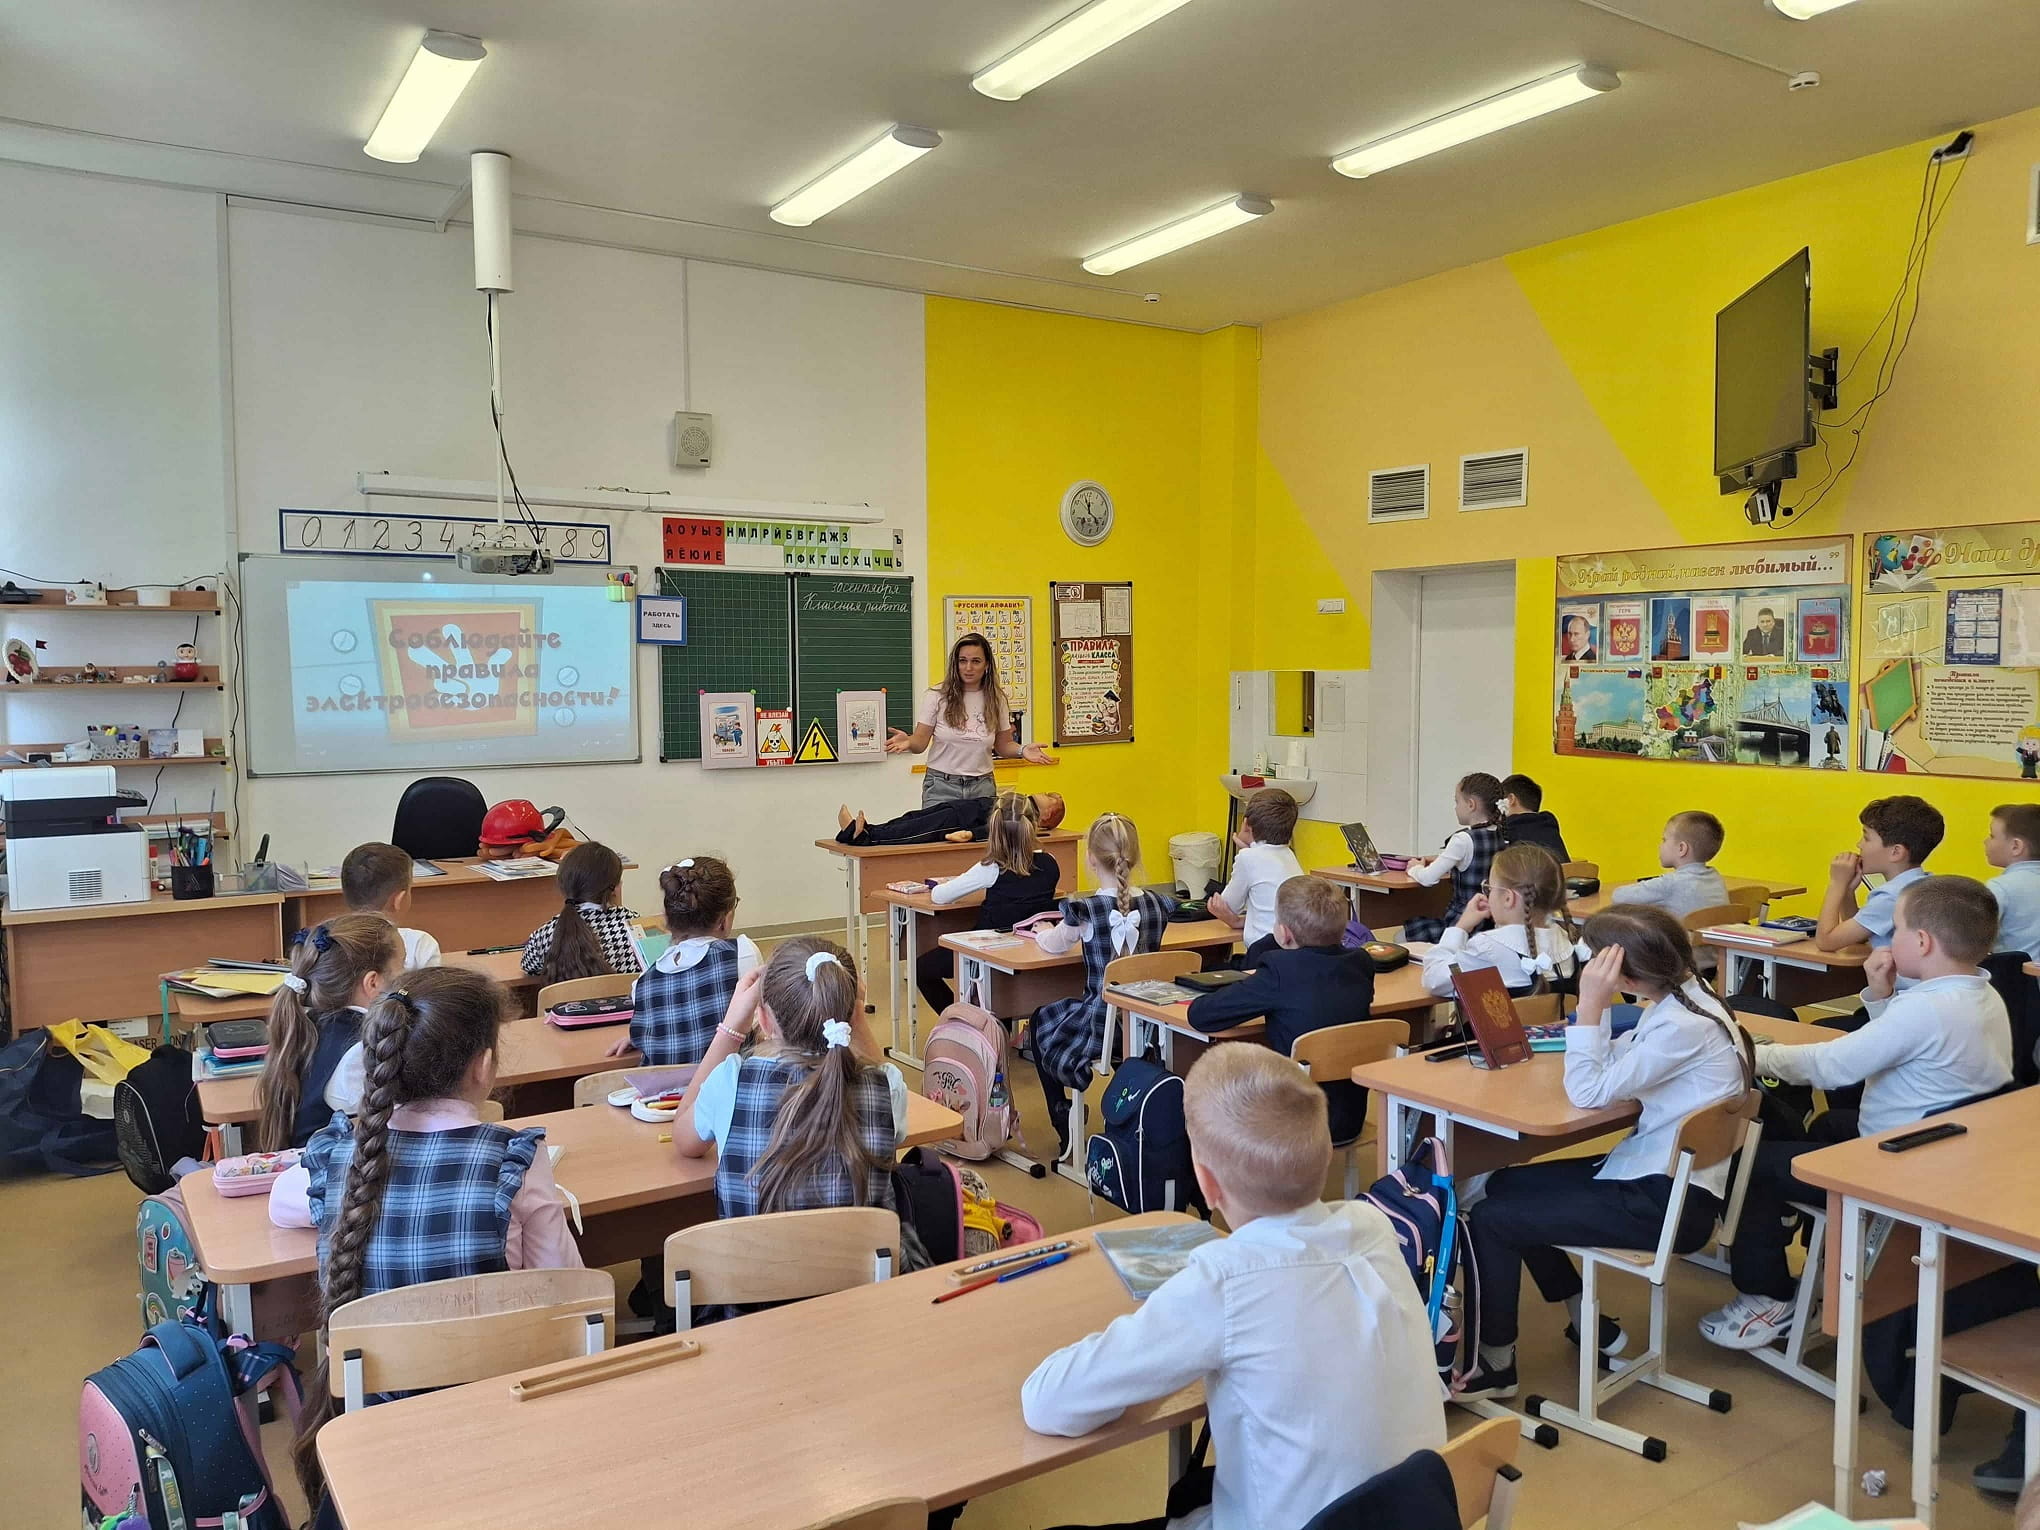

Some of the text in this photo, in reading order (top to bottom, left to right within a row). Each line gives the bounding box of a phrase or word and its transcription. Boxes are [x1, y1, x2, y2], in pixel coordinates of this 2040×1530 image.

[302, 516, 322, 547] 0
[343, 519, 355, 548] 1
[372, 519, 390, 550] 2
[405, 521, 422, 551] 3
[440, 522, 454, 552] 4
[561, 528, 577, 557] 8
[590, 530, 605, 558] 9
[666, 524, 902, 544] А О У Ы Э Н М Л Р Й Б В Г Д Ж З Ъ
[666, 548, 902, 568] Я Ё Ю И Е П Ф К Т Ш С Х Ц Ч Щ Ь
[863, 596, 909, 613] работа
[389, 628, 562, 657] Соблюдайте
[1070, 641, 1114, 651] ПРАВИЛА
[426, 663, 539, 682] правила
